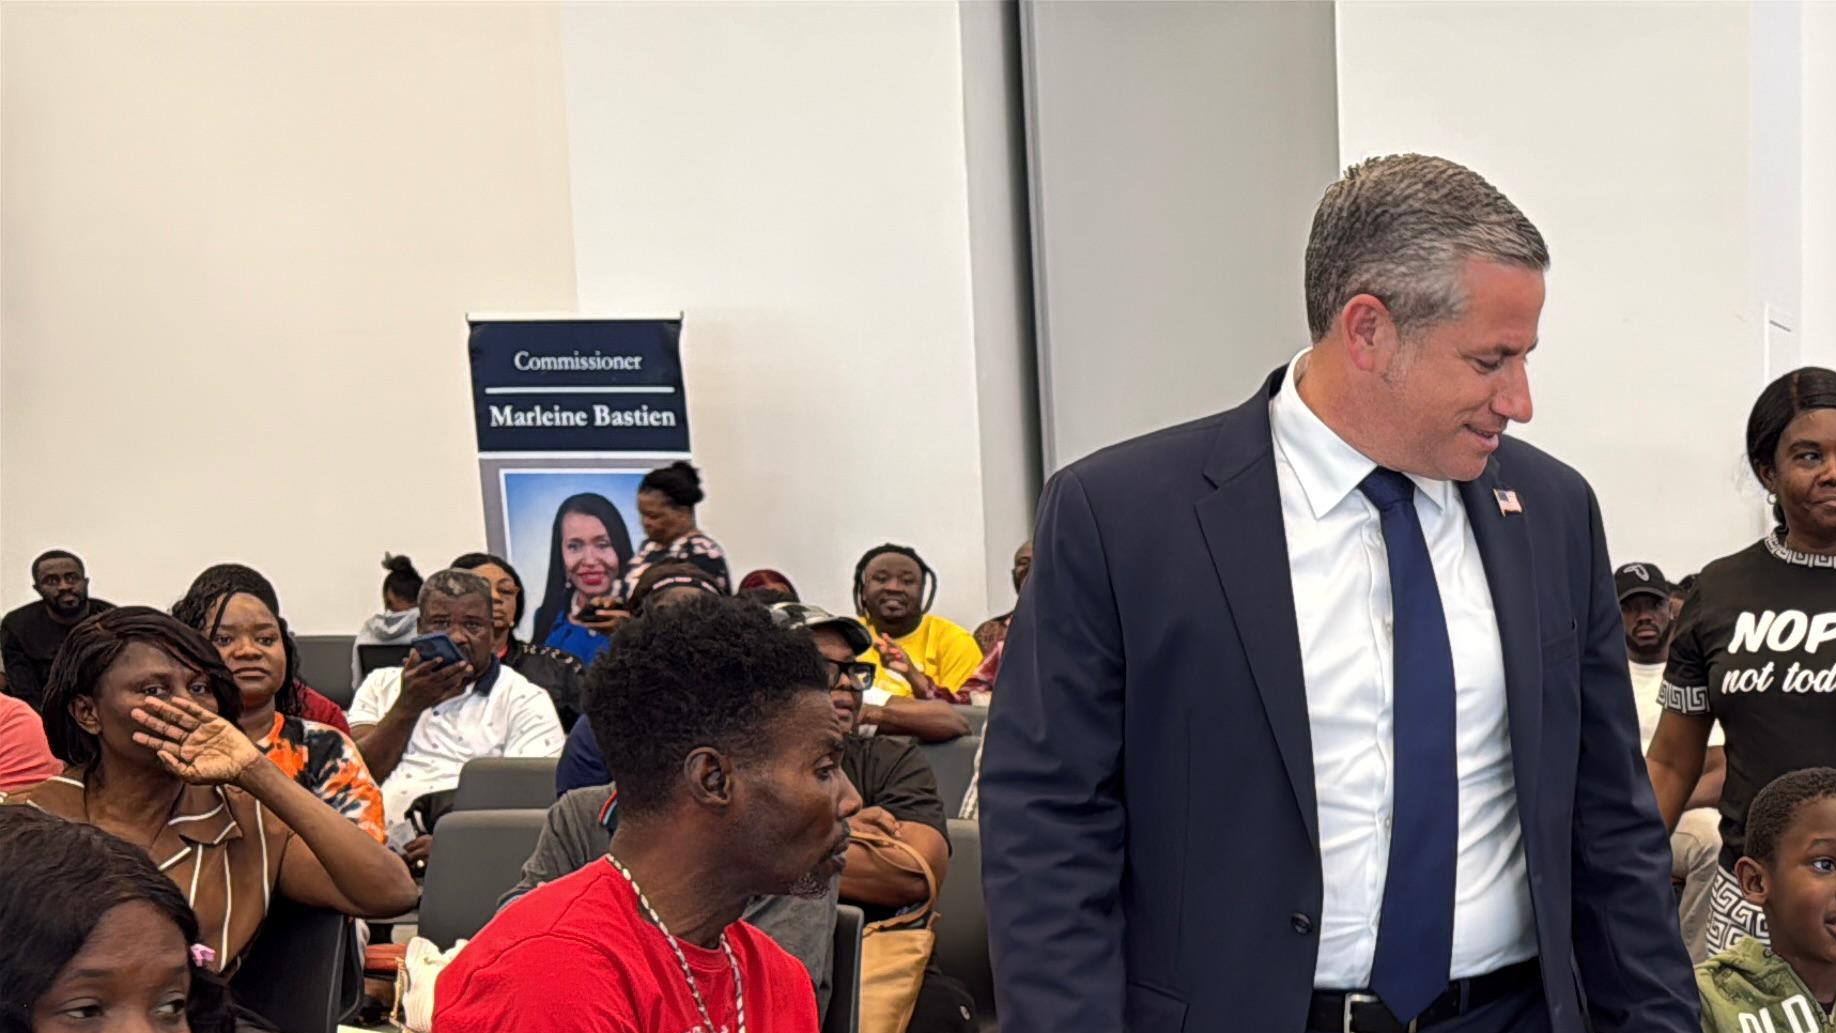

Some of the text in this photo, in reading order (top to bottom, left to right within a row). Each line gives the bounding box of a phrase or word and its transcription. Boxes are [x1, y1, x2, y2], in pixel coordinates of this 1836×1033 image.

[514, 351, 642, 371] Commissioner
[489, 404, 676, 427] Marleine Bastien
[1721, 661, 1775, 694] not
